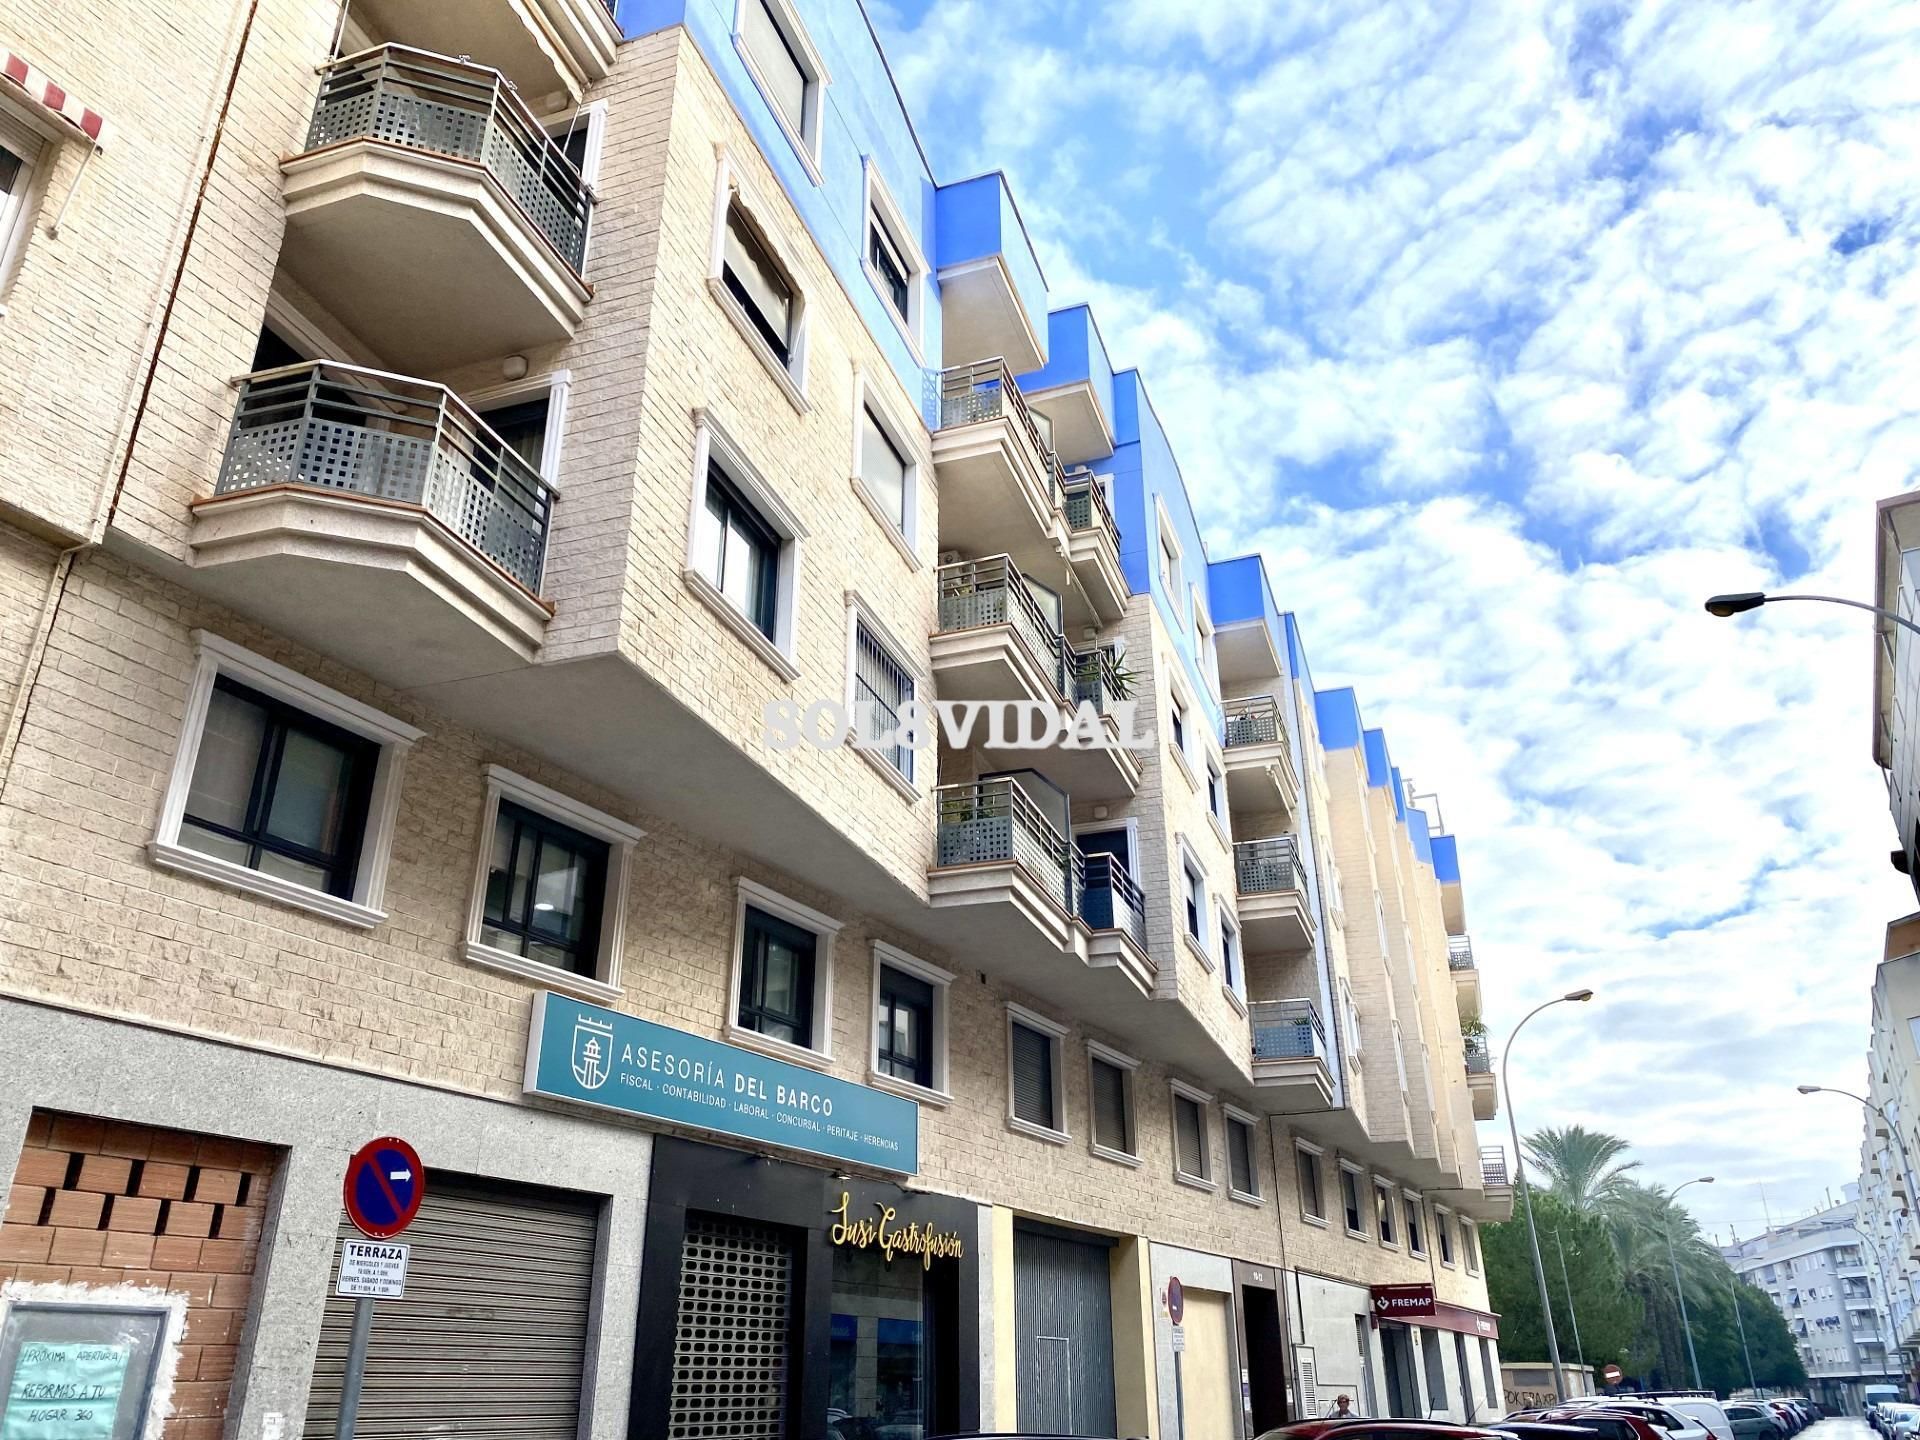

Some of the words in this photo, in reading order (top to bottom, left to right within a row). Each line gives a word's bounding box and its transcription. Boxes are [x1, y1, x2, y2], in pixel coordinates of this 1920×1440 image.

[621, 1043, 724, 1089] ASESORÍA
[734, 1073, 768, 1100] DEL
[776, 1085, 833, 1117] BARCO
[620, 1072, 654, 1091] FISCAL
[662, 1083, 727, 1109] CONTABILIDAD
[733, 1101, 769, 1120] LABORAL
[776, 1111, 821, 1132] CONCURSAL
[826, 1124, 858, 1142] PERITAJE
[864, 1135, 899, 1151] HERENCIAS
[874, 1201, 964, 1271] Gastrofusión
[349, 1244, 403, 1260] TERRAZA
[1391, 1297, 1432, 1308] FREMAP
[21, 1383, 77, 1399] REFORMAS
[78, 1384, 88, 1400] A
[91, 1384, 105, 1400] TU
[28, 1408, 68, 1422] HOGAR
[74, 1409, 93, 1421] 360
